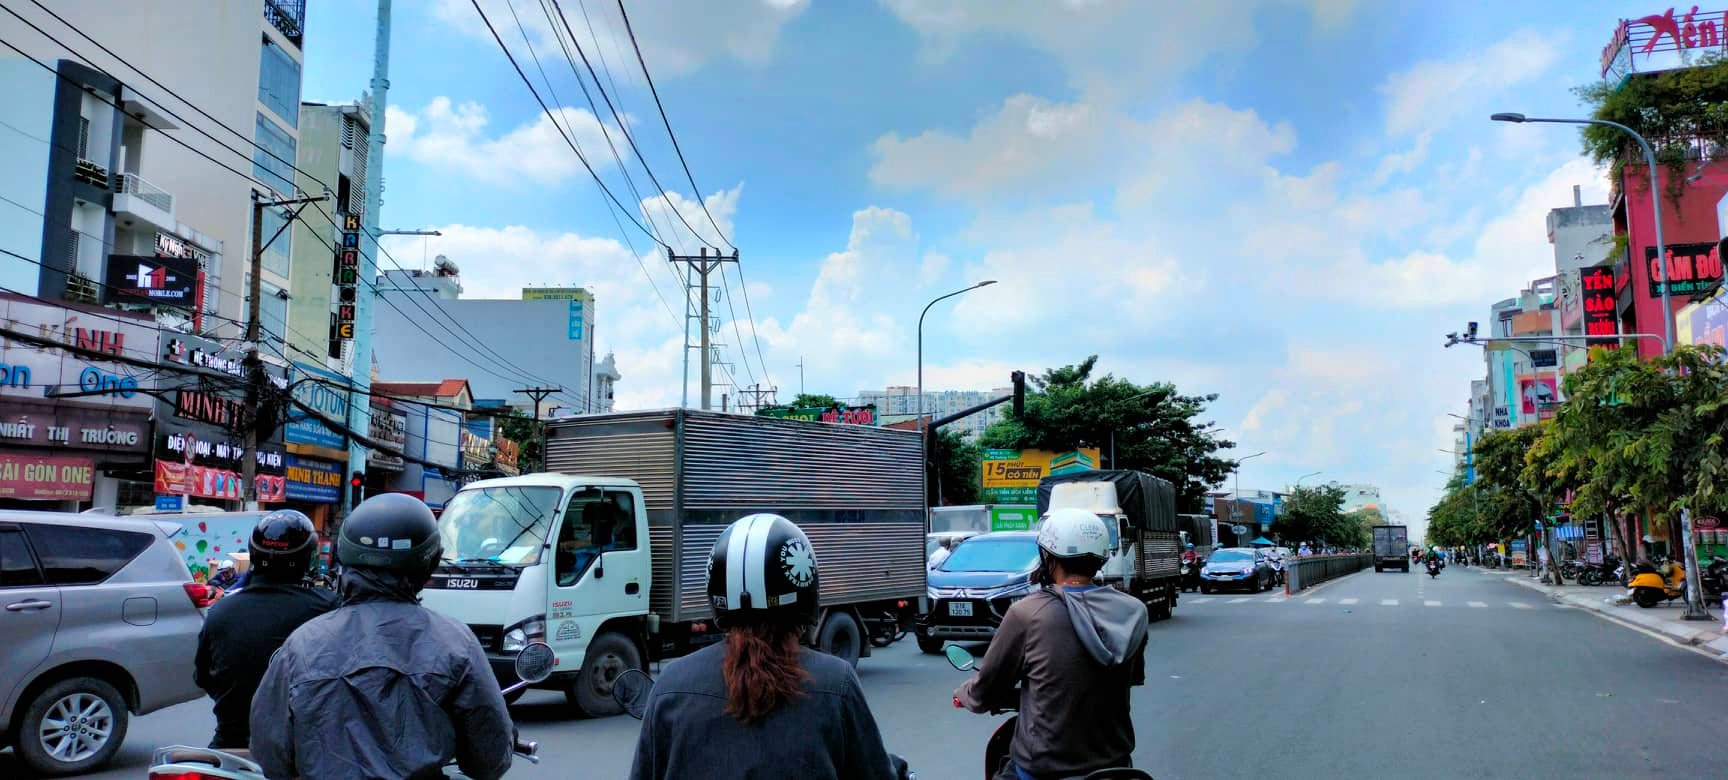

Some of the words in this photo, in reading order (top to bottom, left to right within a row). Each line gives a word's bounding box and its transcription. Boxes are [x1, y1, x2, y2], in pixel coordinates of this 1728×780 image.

[1583, 269, 1613, 290] YẾN
[1585, 293, 1615, 312] SÀO
[81, 366, 138, 398] One
[309, 385, 345, 416] JOTUN
[48, 426, 69, 445] THỊ
[81, 425, 138, 445] TRƯỜNG
[267, 451, 282, 468] KIỆN
[987, 462, 1006, 476] 15
[24, 460, 57, 482] GÒN
[62, 466, 91, 484] ONE
[447, 579, 478, 588] ISUZU
[552, 600, 573, 608] ISUZU
